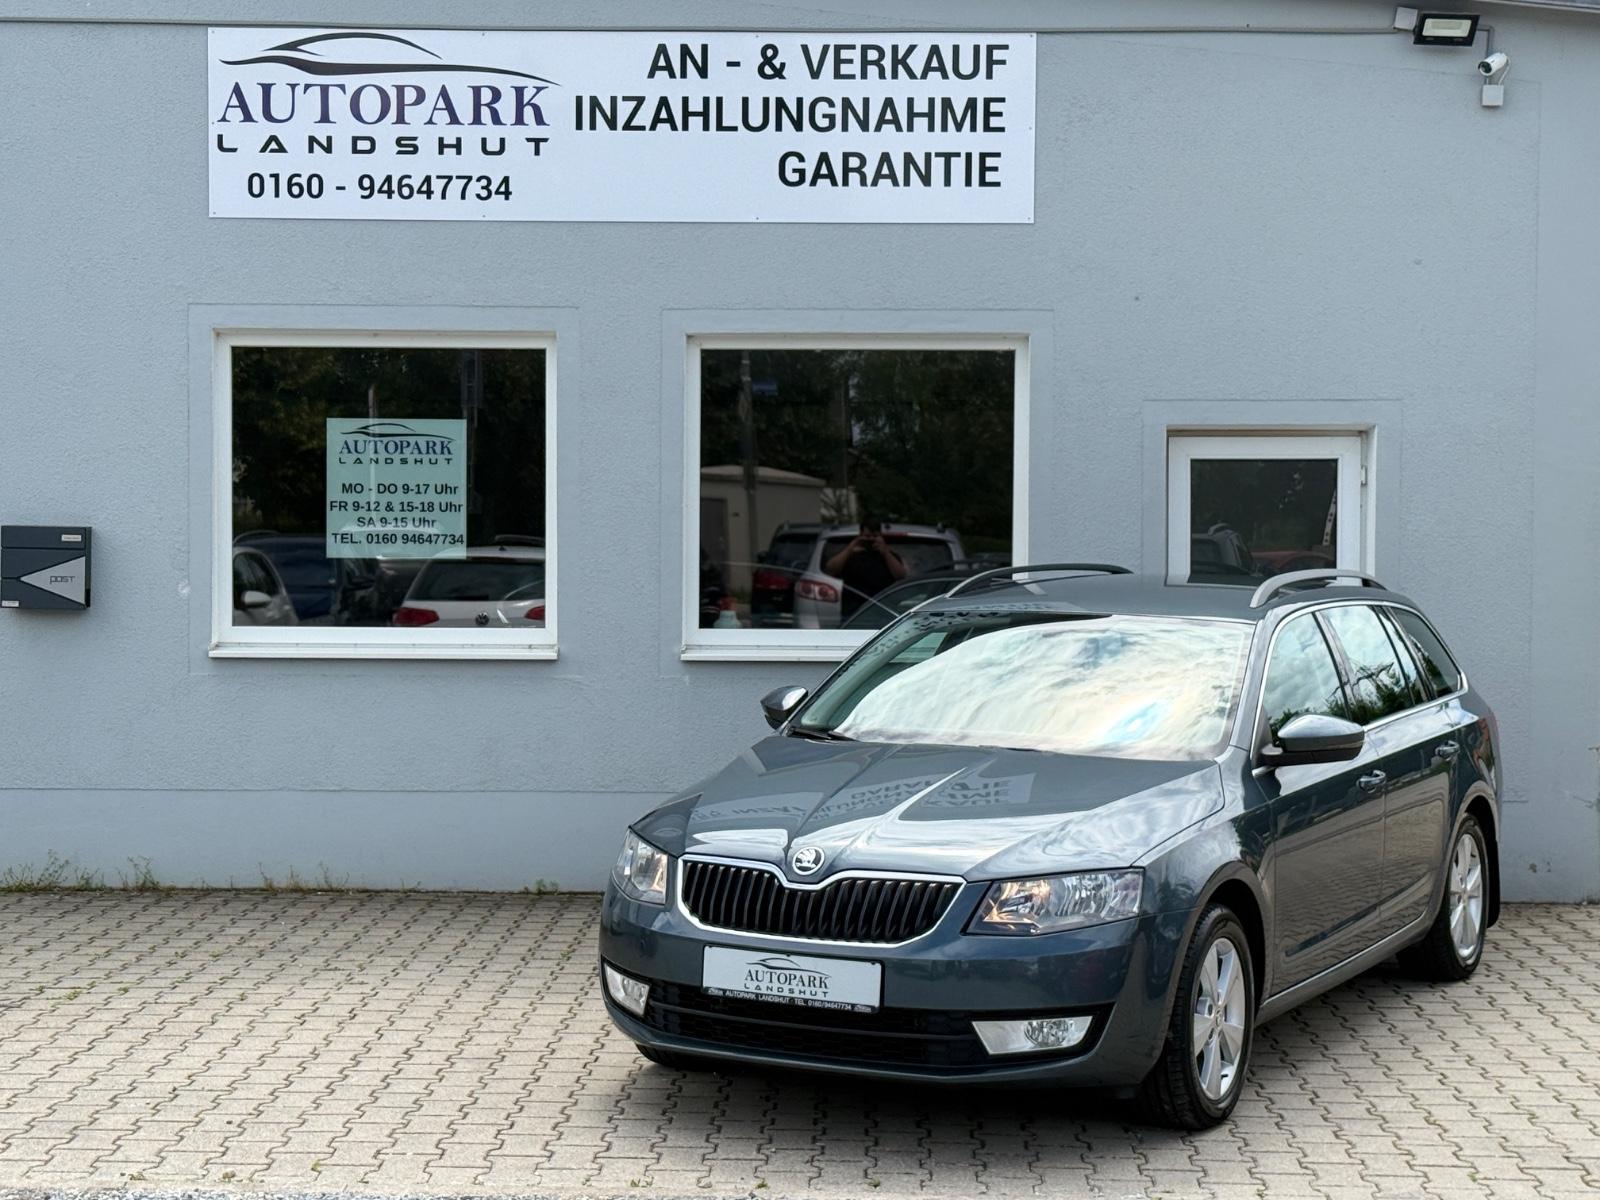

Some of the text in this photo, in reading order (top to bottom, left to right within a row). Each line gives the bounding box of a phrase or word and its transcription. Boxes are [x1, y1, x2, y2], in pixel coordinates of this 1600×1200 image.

[647, 43, 709, 80] AN
[757, 43, 787, 81] &
[800, 43, 1010, 81] VERKAUF
[217, 81, 551, 127] AUTOPARK
[575, 95, 1007, 133] INZAHLUNGNAHME
[216, 133, 550, 157] LANDSHUT
[778, 151, 1002, 188] GARANTIE
[247, 172, 325, 200] 0160
[357, 174, 513, 202] 94647734
[339, 439, 453, 455] AUTOPARK
[338, 457, 453, 465] LANDSHUT
[341, 482, 365, 495] MO
[377, 483, 398, 495] DO
[402, 483, 431, 495] 9-17
[434, 483, 459, 495] Uhr
[329, 500, 463, 513] FR 9-12 & 15-18 Uhr
[356, 516, 437, 528] SA 9-15 Uhr
[332, 532, 465, 545] TEL. 0160 94647734
[744, 969, 830, 990] AUTOPARK
[725, 990, 757, 1000] AUTOPARK
[758, 993, 790, 1004] LANDSHUT
[744, 984, 829, 998] LANDSHUT
